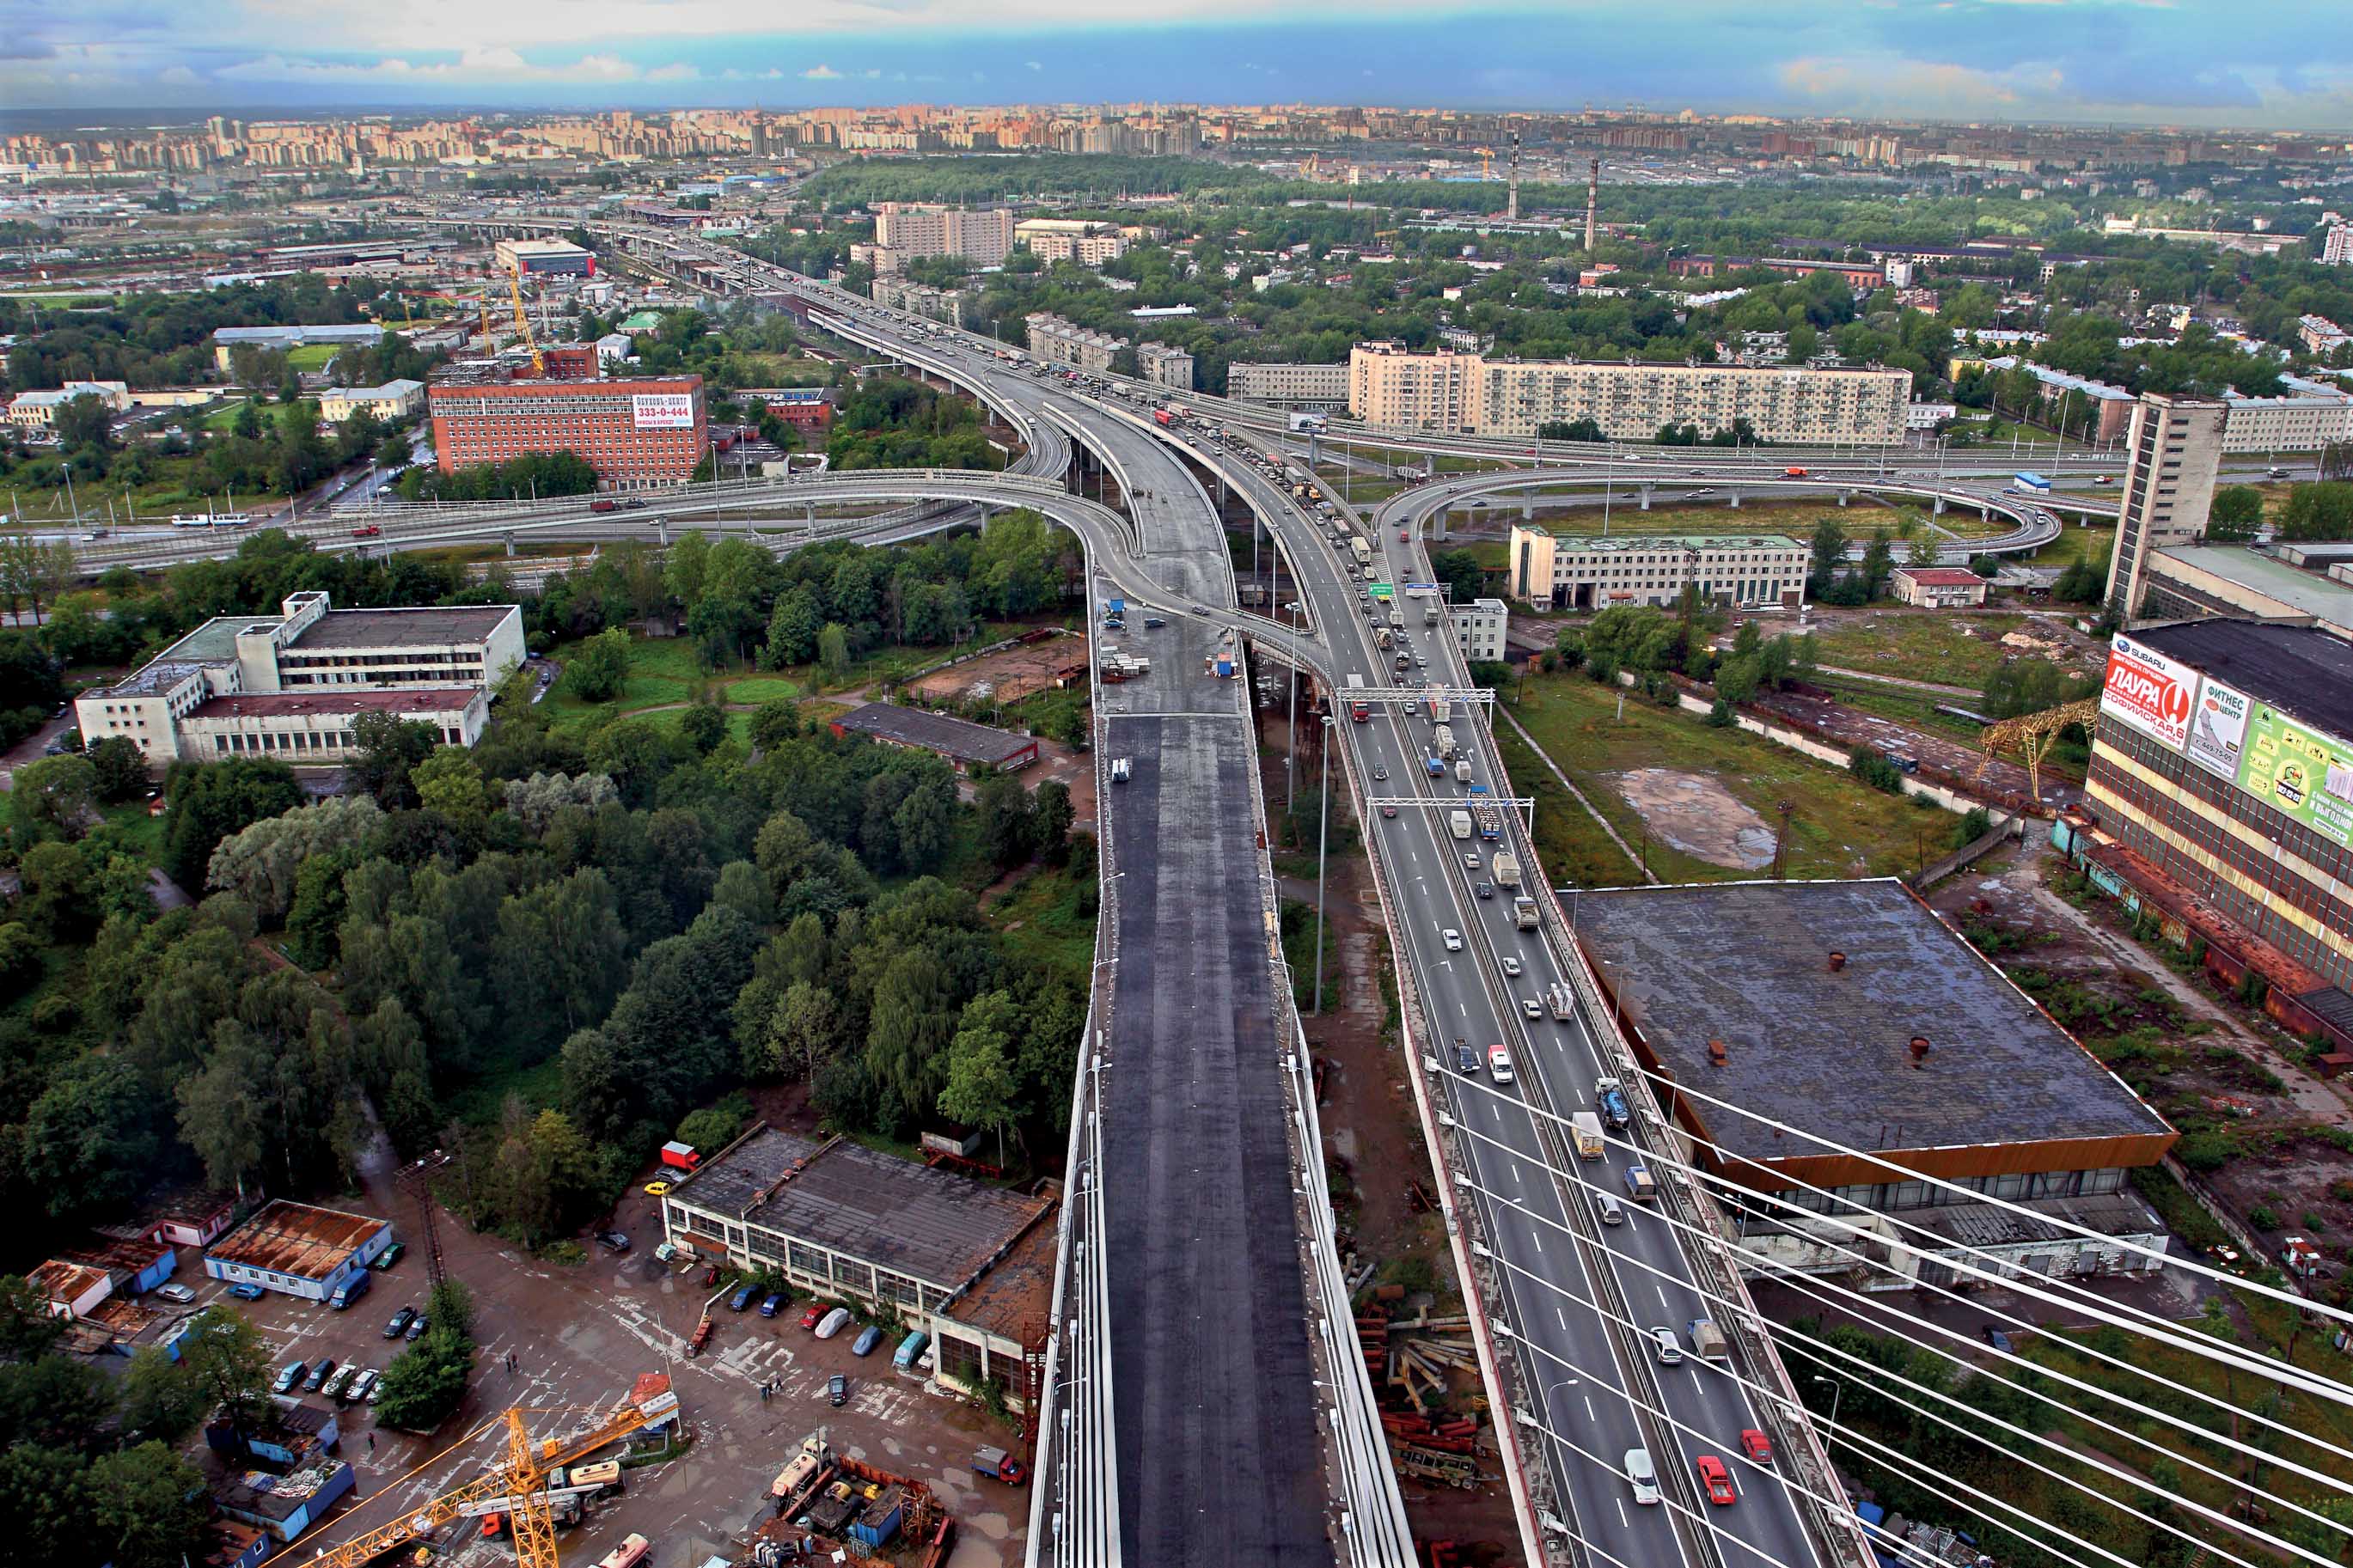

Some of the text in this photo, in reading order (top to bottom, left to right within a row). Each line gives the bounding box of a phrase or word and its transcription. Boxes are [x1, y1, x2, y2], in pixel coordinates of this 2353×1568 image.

[639, 407, 688, 417] 333-0-444
[2131, 648, 2165, 670] SUBARU
[2109, 665, 2160, 708] ЛАУРА
[2208, 686, 2243, 710] ФИТНЕС
[2219, 705, 2241, 720] ЦЕНТР
[2202, 742, 2232, 762] 449-75-09
